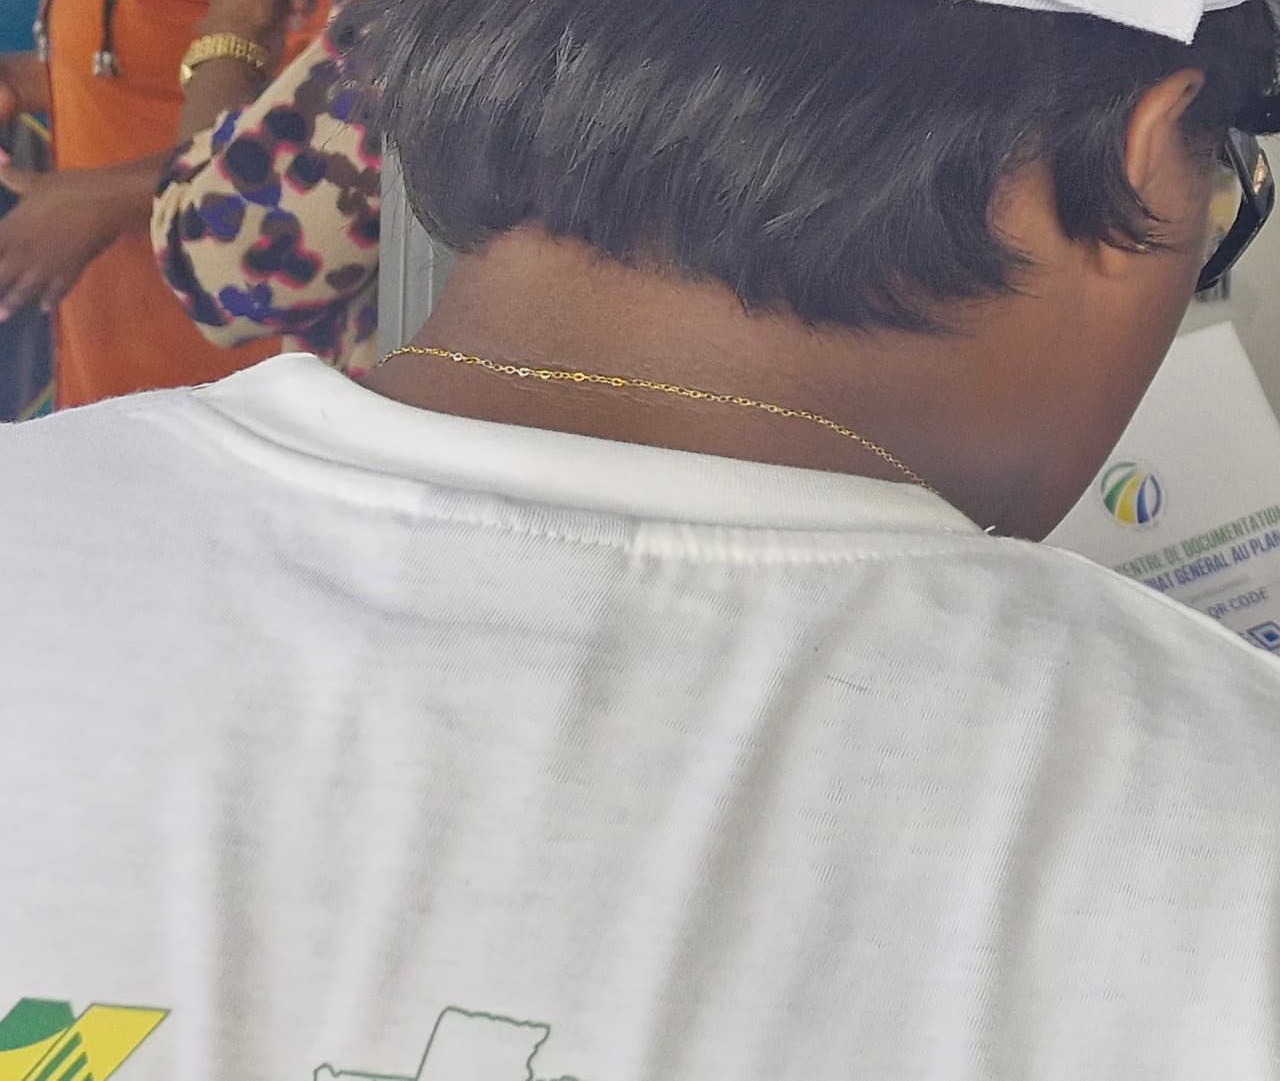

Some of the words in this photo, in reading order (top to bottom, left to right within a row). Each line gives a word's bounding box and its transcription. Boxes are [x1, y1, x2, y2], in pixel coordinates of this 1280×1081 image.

[1163, 544, 1182, 565] DE
[1230, 544, 1250, 565] AU
[1229, 584, 1271, 610] CODE
